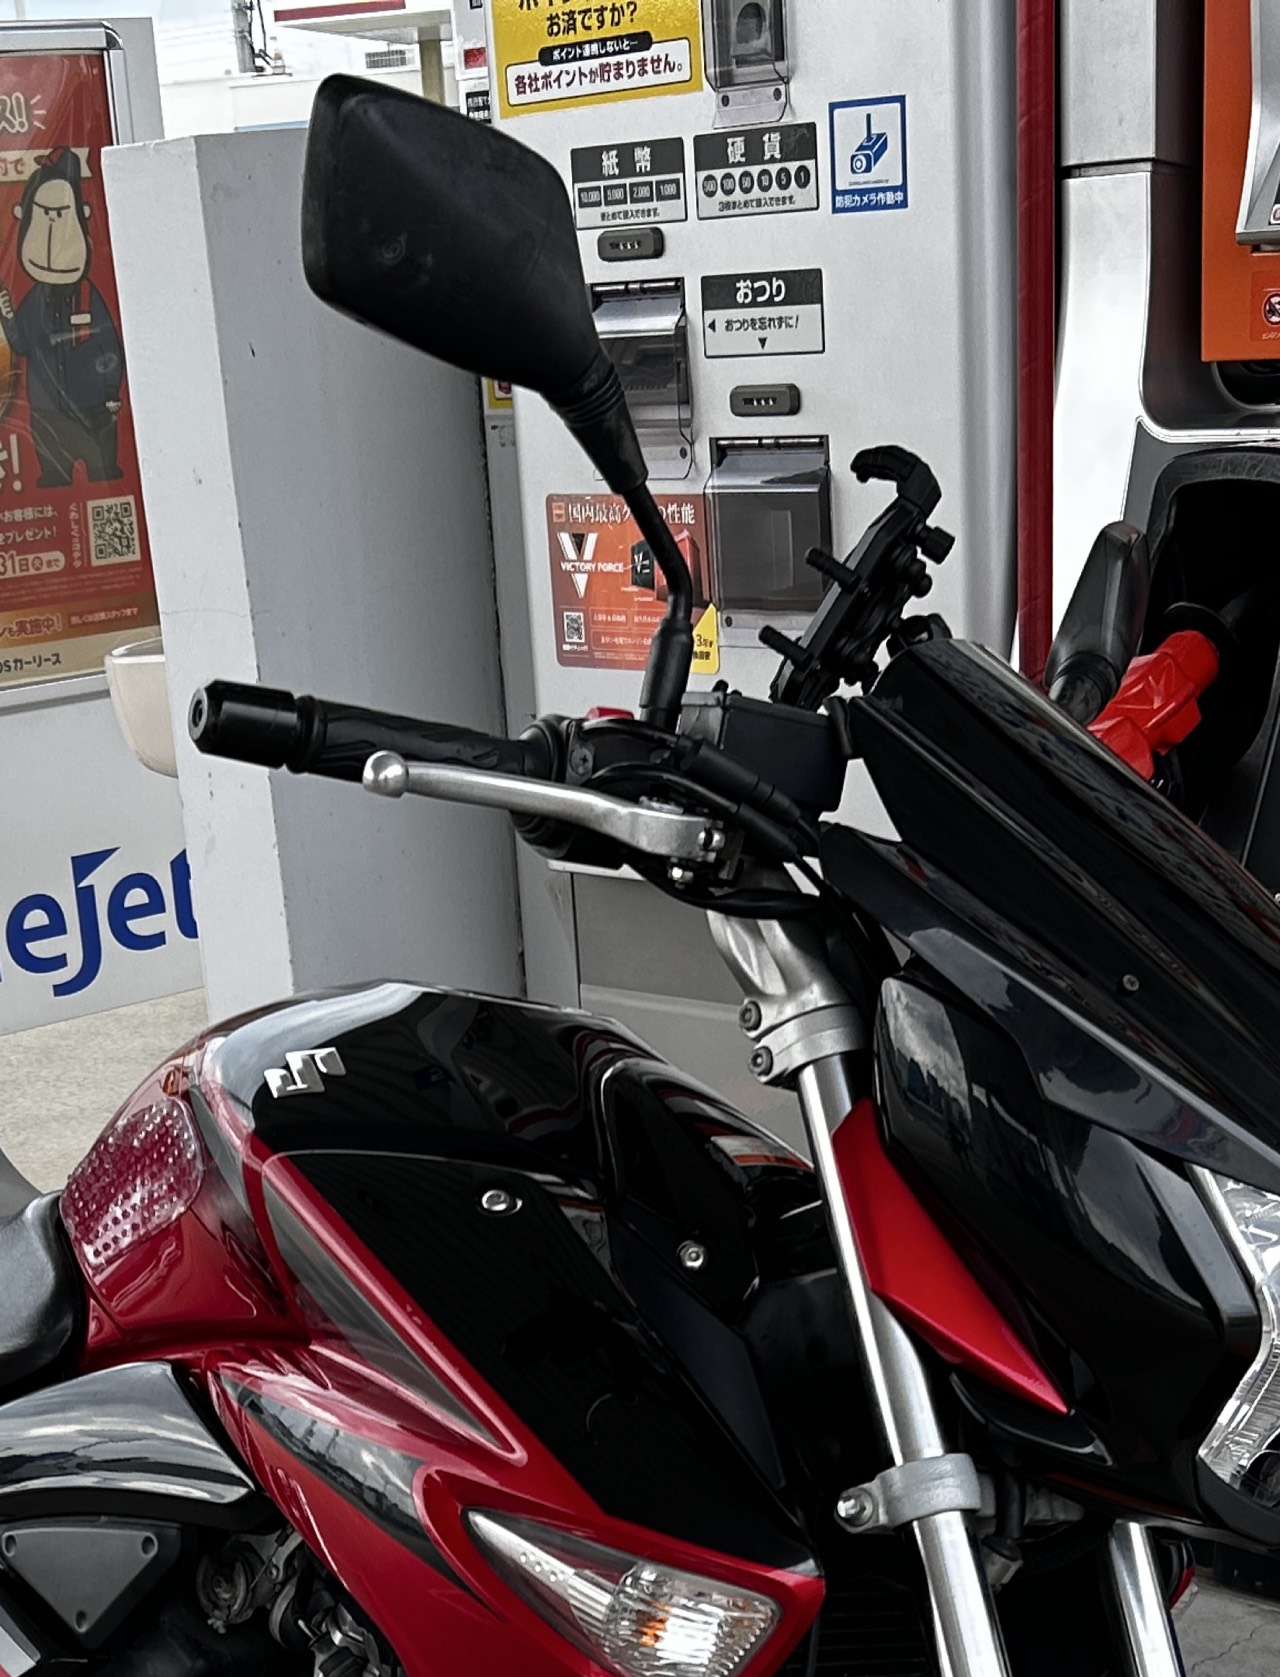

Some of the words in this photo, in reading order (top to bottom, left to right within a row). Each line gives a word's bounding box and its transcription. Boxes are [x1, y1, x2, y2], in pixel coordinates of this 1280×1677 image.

[835, 191, 904, 209] 防犯カメラ作動中
[735, 277, 786, 304] おつり
[724, 314, 800, 332] おつりを忘れずに!
[561, 561, 596, 572] VICTORY
[597, 562, 624, 573] FORCE
